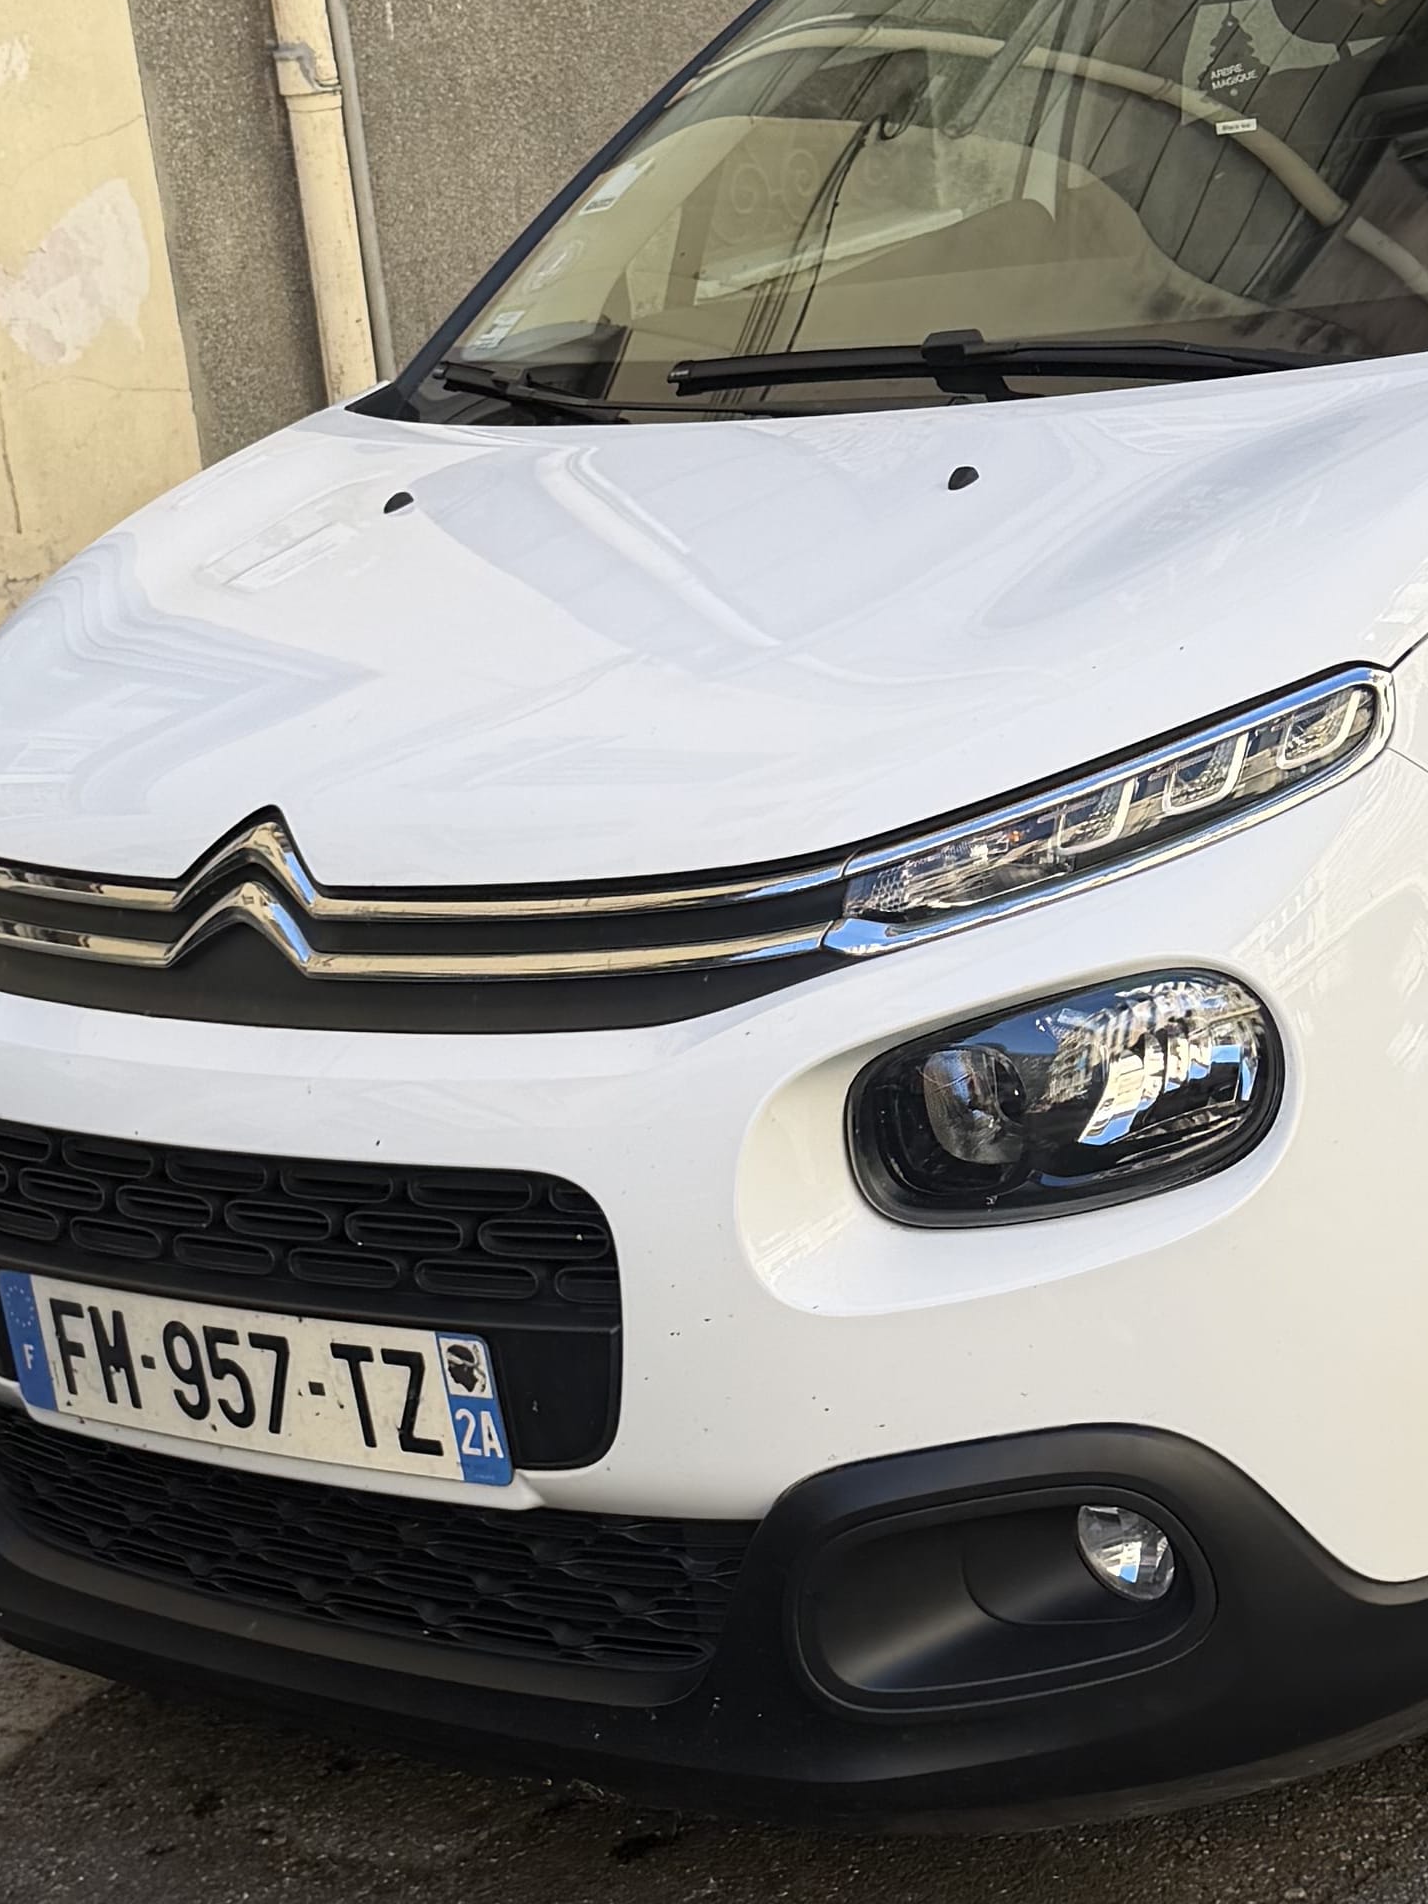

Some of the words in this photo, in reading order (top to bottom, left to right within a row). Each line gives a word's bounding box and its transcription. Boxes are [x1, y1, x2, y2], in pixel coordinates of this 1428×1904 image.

[23, 1343, 35, 1370] F
[49, 1297, 445, 1457] FM-957-TZ
[455, 1408, 505, 1459] 2A
